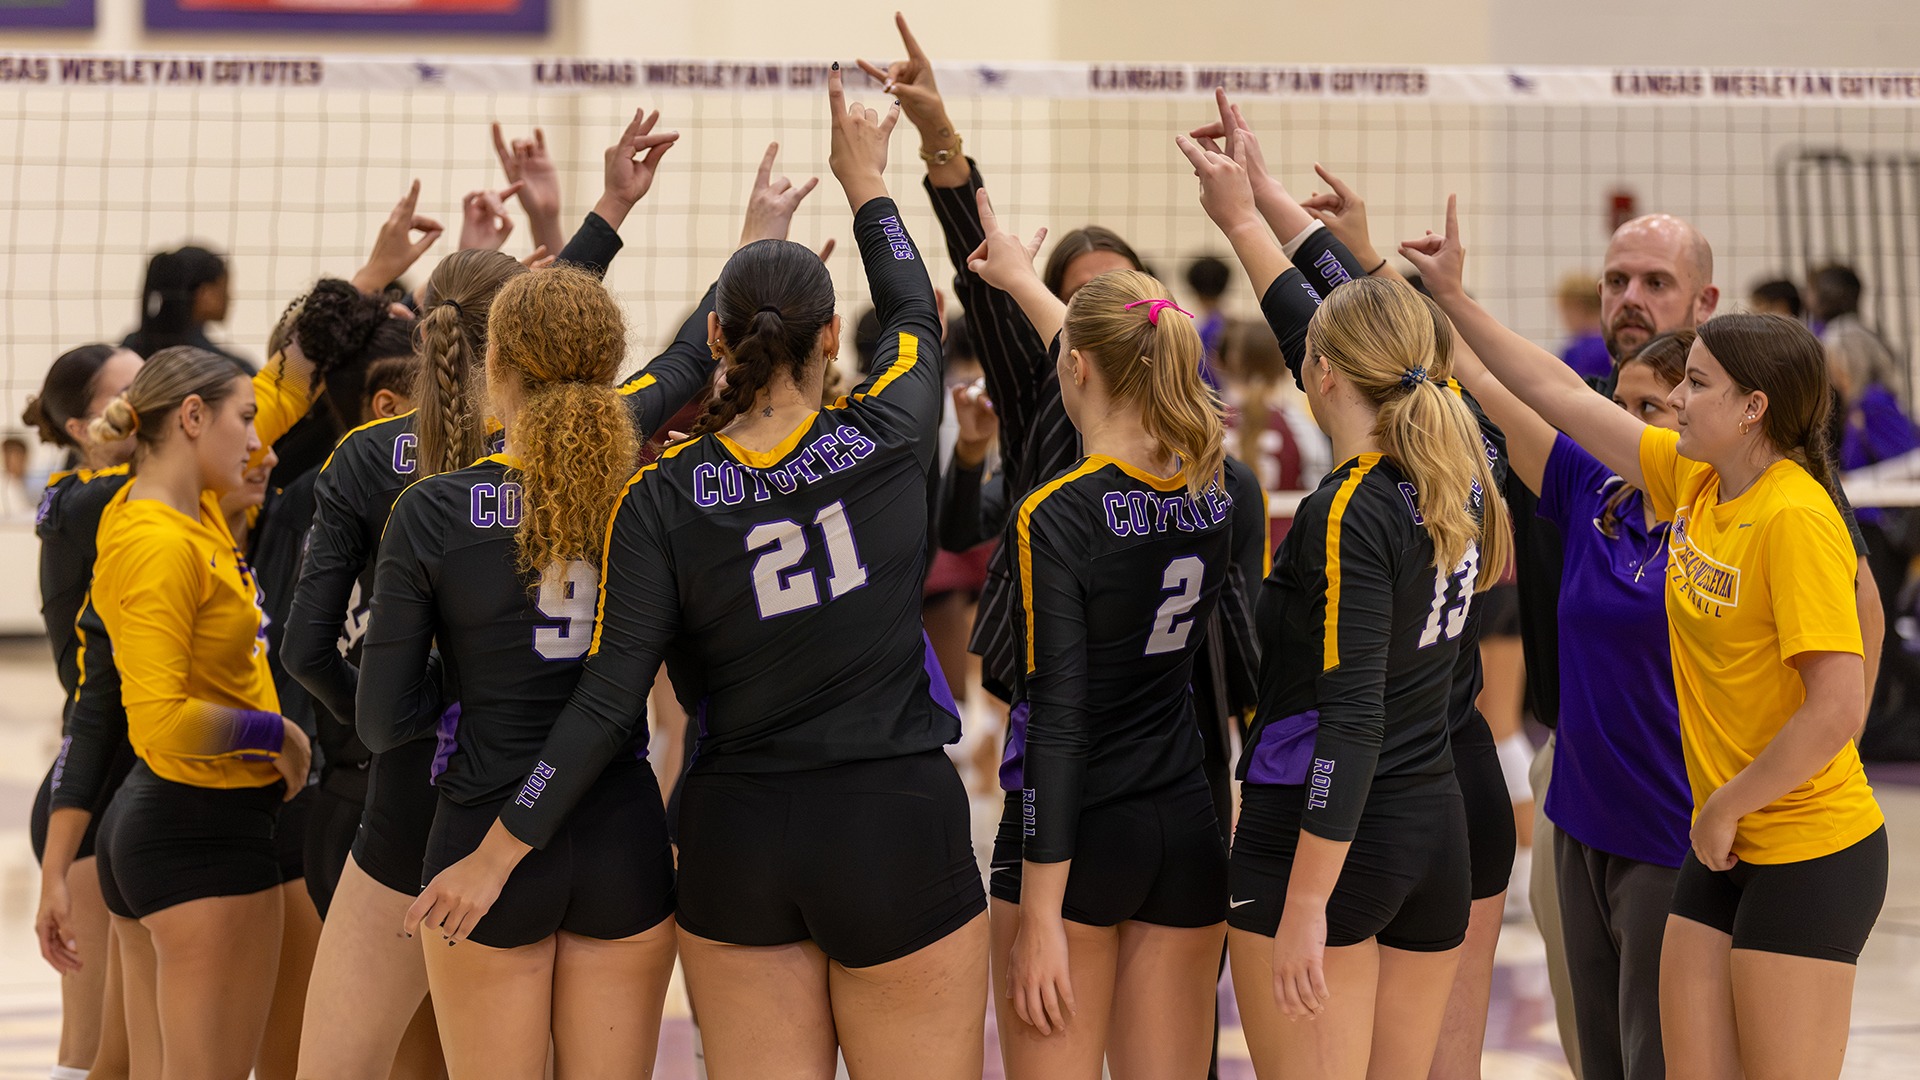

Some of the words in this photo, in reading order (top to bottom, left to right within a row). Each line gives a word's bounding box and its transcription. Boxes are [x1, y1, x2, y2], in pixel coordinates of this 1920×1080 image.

[60, 58, 205, 85] WESLEYAN
[211, 60, 324, 85] COYOTES
[532, 60, 637, 87] KANSAS
[645, 62, 784, 89] WESLEYAN
[1090, 66, 1184, 92] KANSAS
[1195, 68, 1323, 94] WESLEYAN
[1330, 70, 1428, 96] COYOTES
[1612, 73, 1703, 97] KANSAS
[1709, 74, 1834, 98] WESLEYAN
[879, 215, 914, 260] YOTES
[693, 425, 876, 507] COYOTES
[743, 498, 869, 621] 21
[532, 560, 599, 662] 9
[1143, 553, 1206, 656] 2
[1417, 538, 1479, 650] 13
[515, 760, 556, 809] ROLL
[1307, 757, 1335, 810] ROLL
[1022, 788, 1036, 839] ROLL
